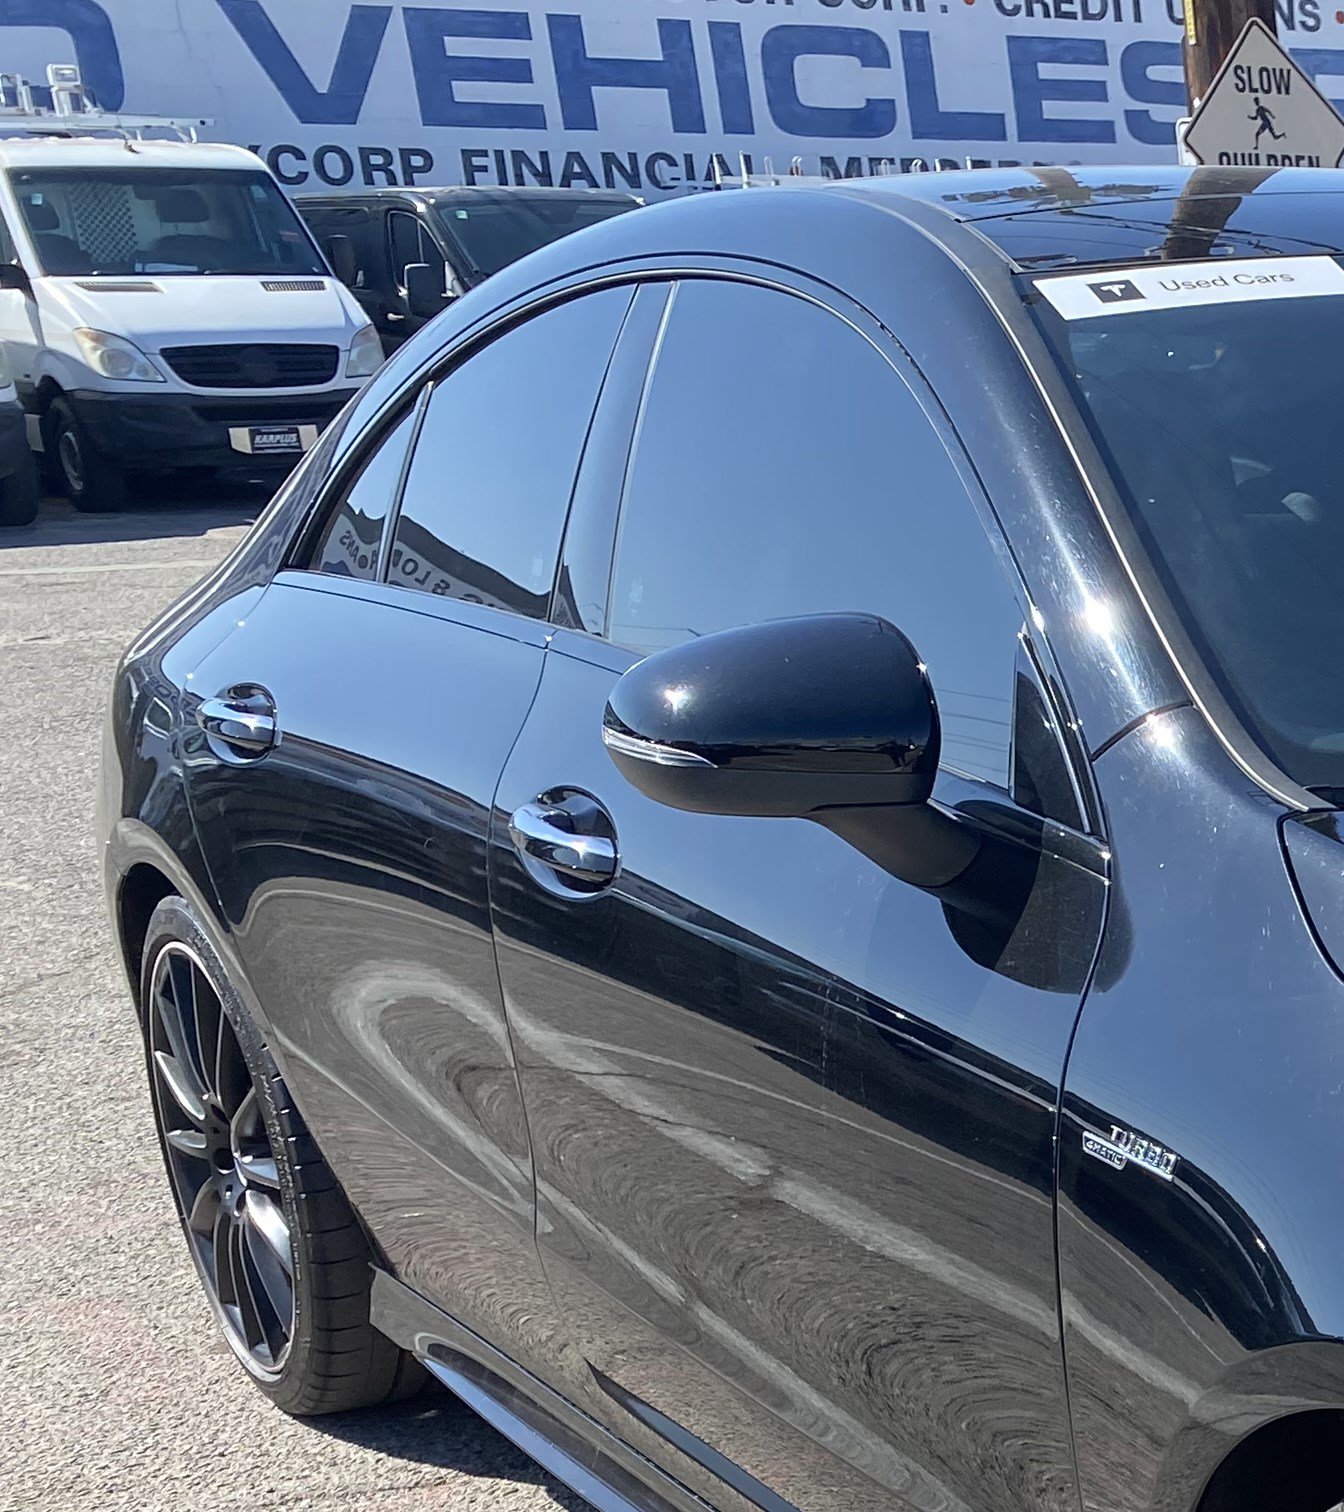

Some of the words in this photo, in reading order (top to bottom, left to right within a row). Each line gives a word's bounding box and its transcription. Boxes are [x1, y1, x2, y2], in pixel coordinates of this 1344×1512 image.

[215, 0, 1186, 145] VEHICLES
[1234, 65, 1291, 95] SLOW
[1159, 275, 1229, 292] Used
[1233, 270, 1296, 288] Cars
